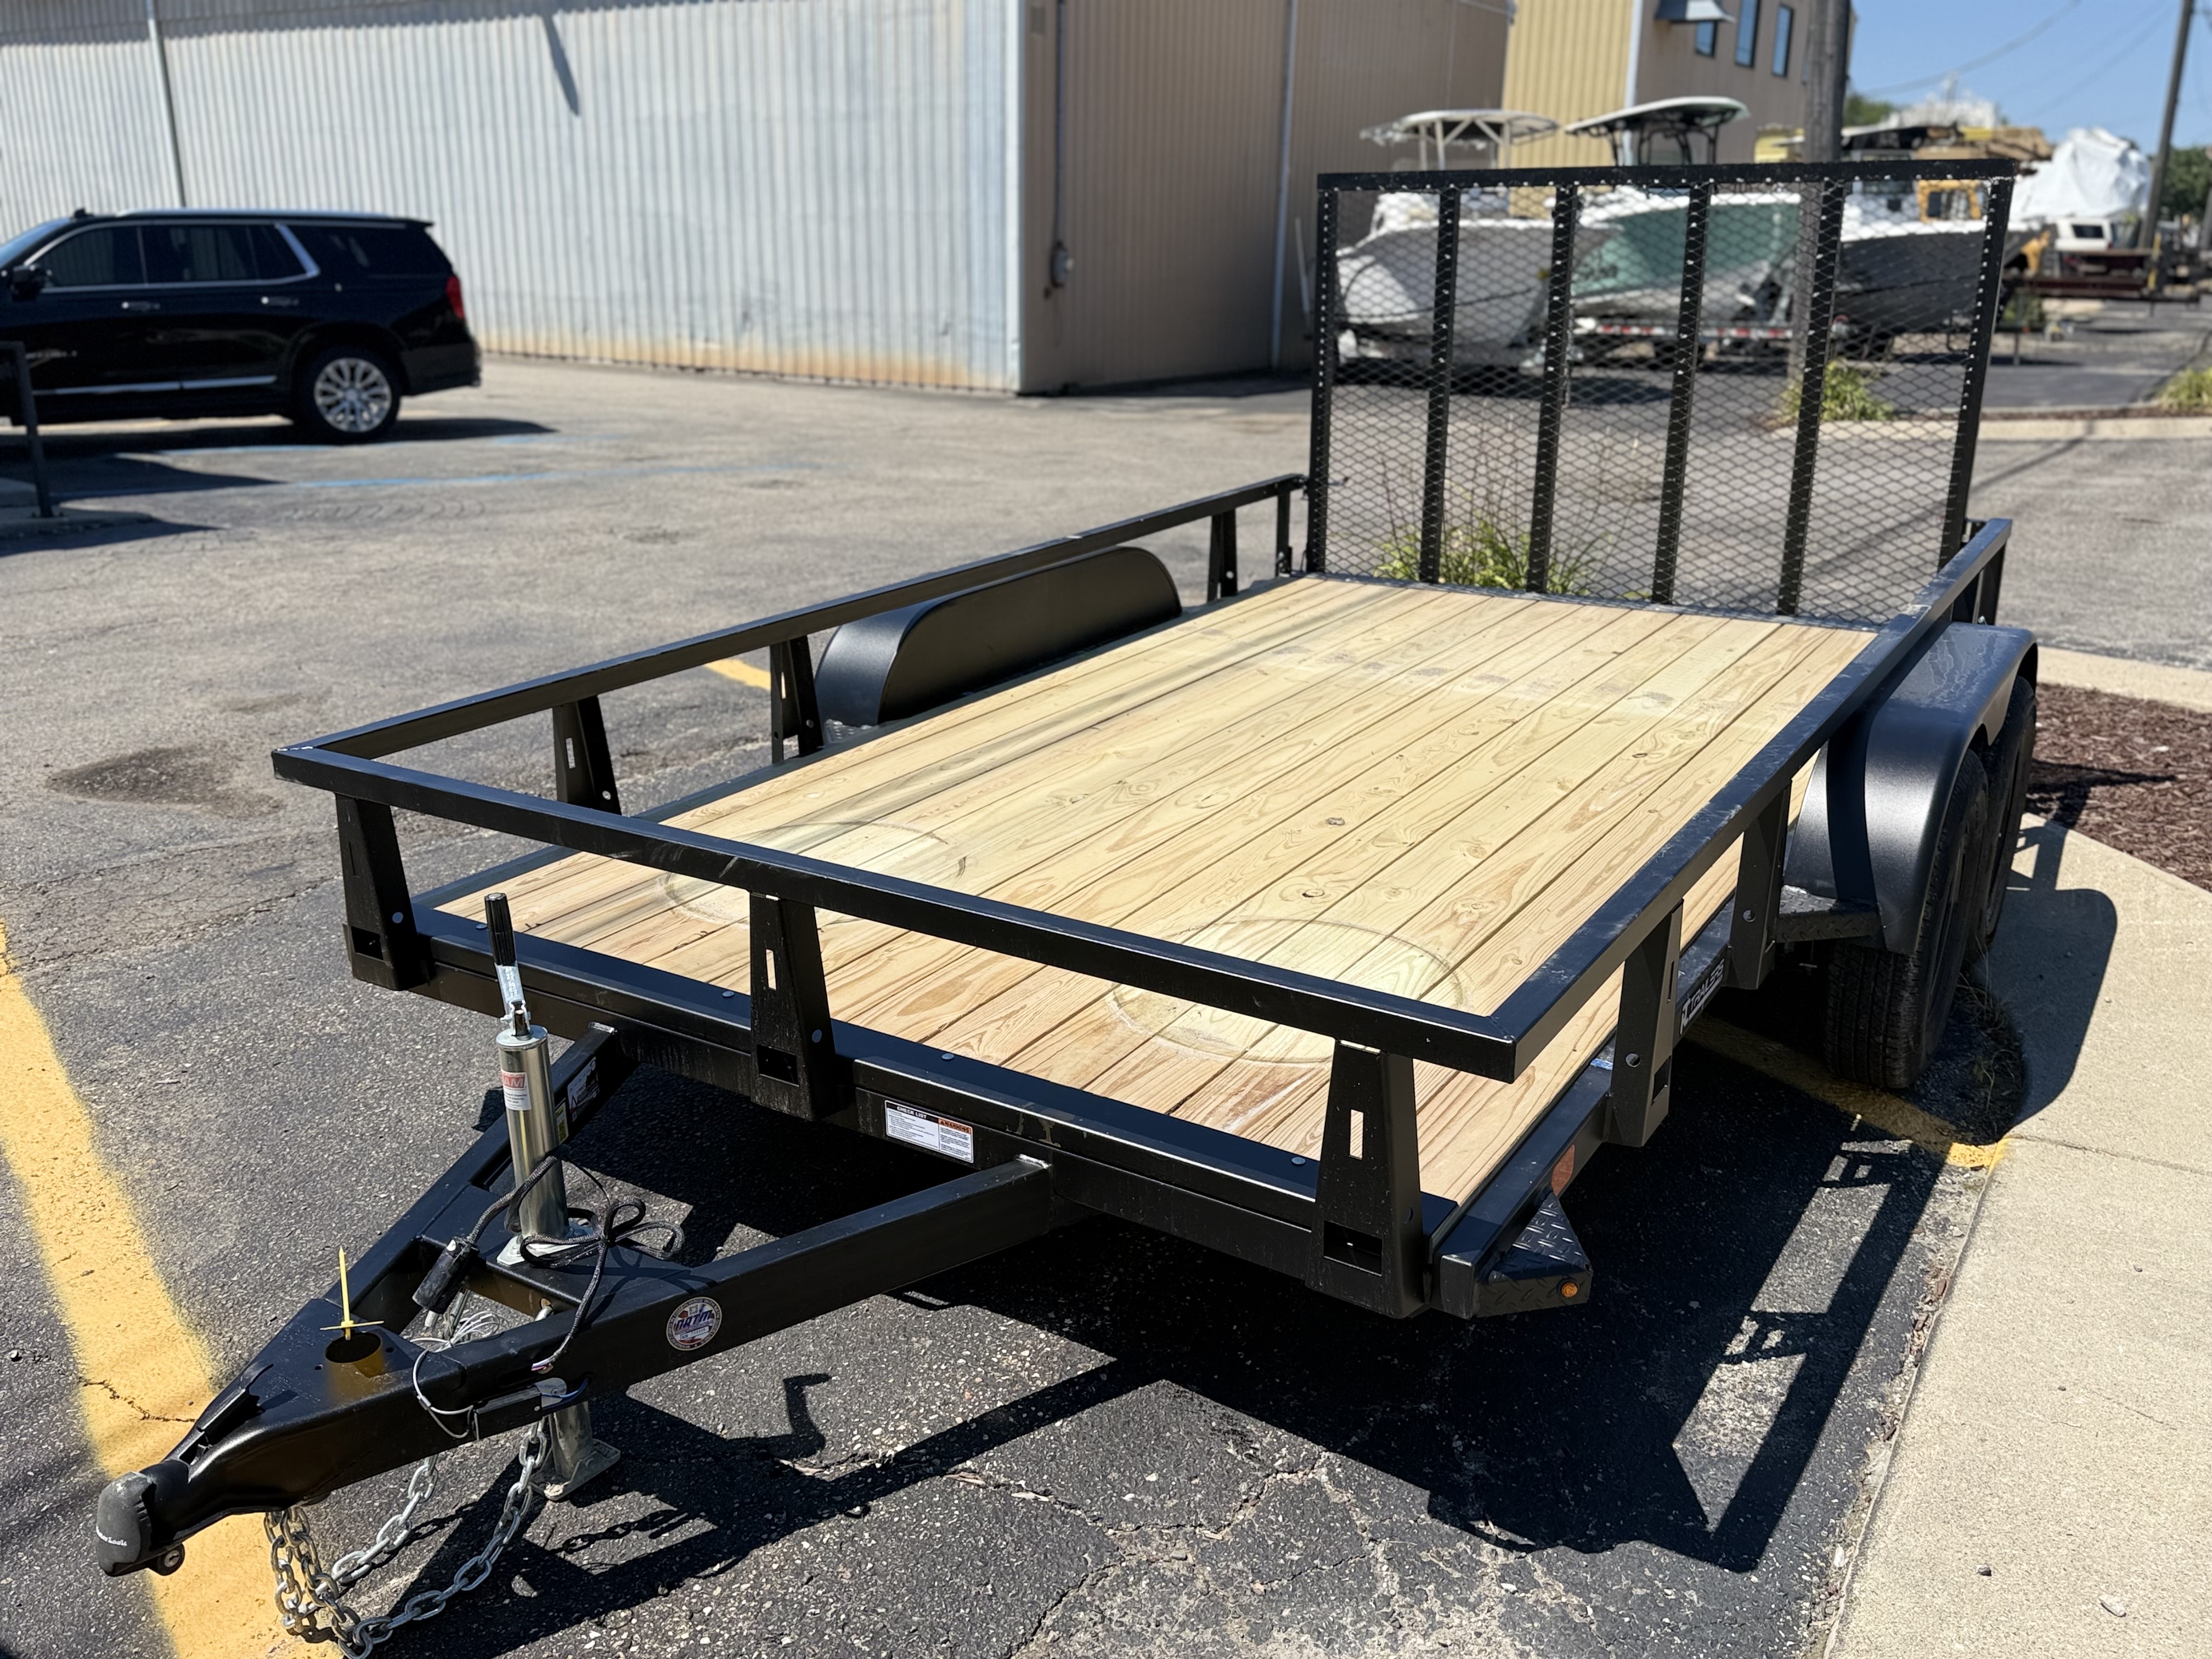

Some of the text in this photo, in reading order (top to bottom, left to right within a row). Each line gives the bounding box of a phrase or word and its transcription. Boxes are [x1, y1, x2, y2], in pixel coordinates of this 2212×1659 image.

[896, 1106, 915, 1116] CHECK
[944, 1121, 969, 1133] WARNING
[674, 1309, 713, 1330] NATM
